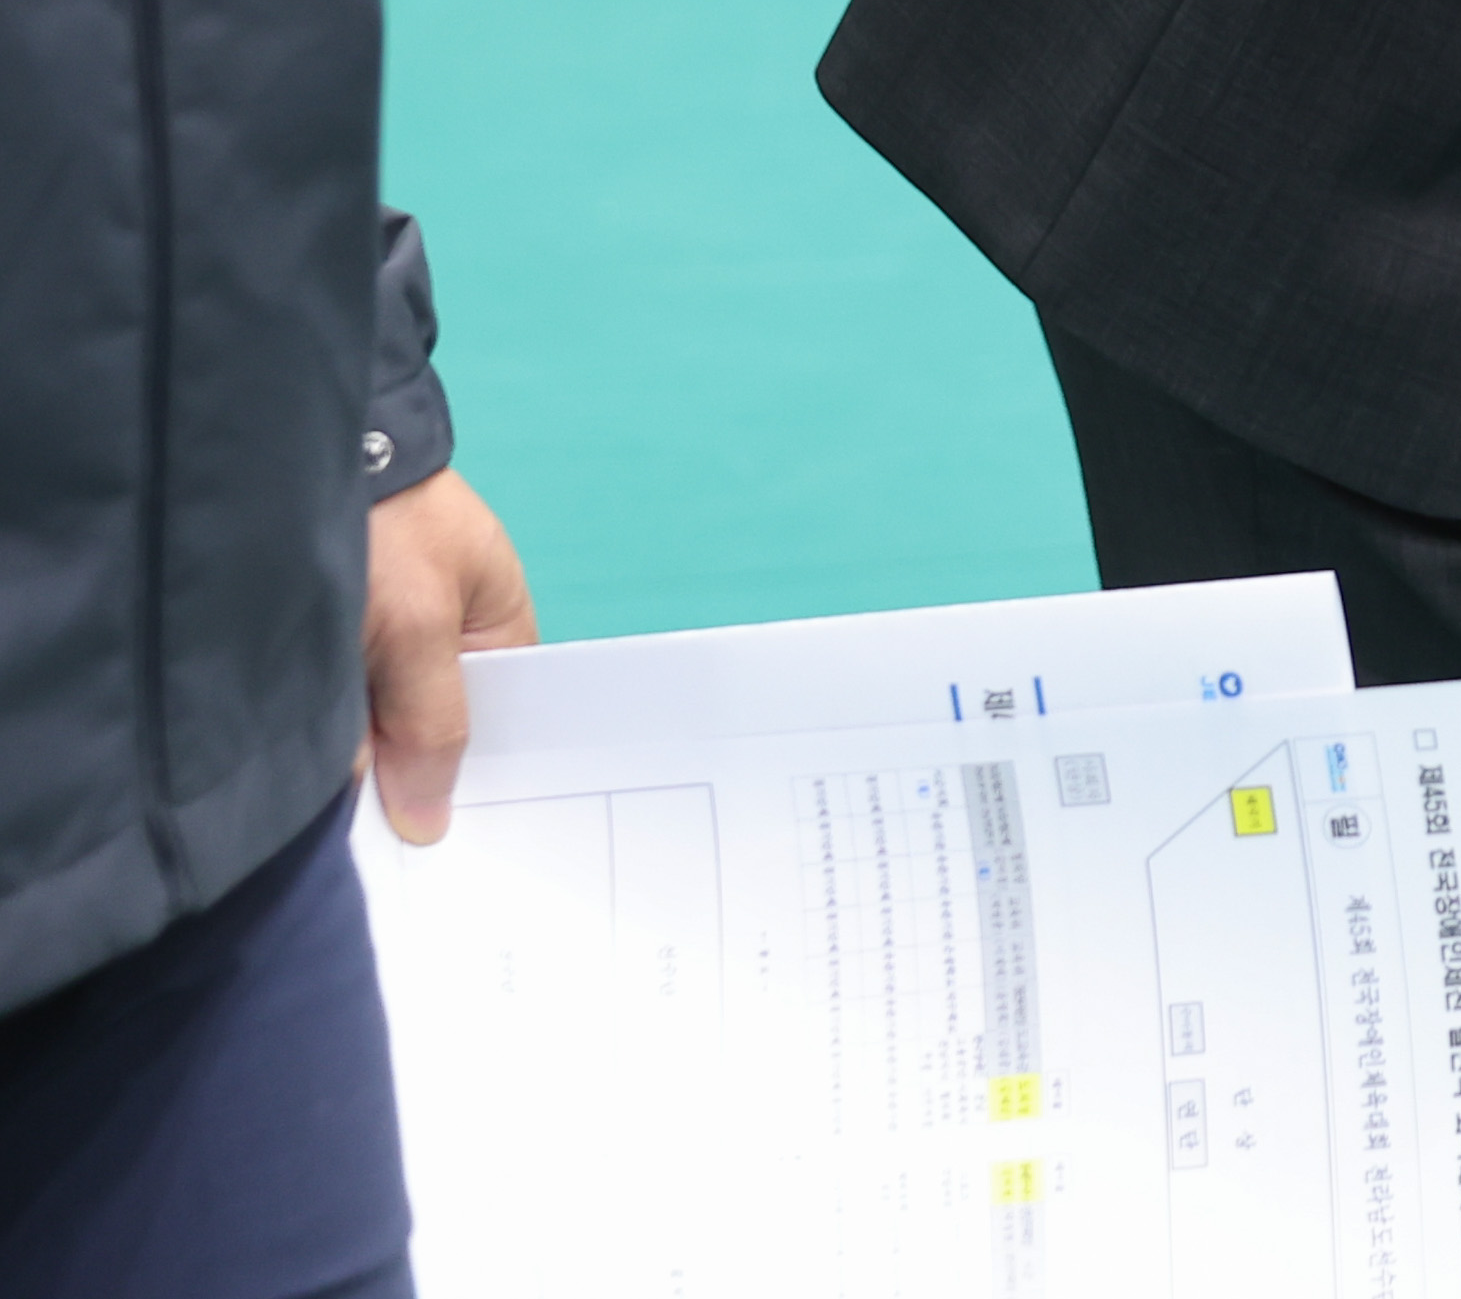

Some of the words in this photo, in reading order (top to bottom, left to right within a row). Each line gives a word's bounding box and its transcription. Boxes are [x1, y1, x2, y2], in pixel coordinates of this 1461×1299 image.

[1418, 764, 1452, 835] 제45회
[1345, 893, 1377, 956] 제45회
[1351, 966, 1391, 1152] 전국장애인체육대회
